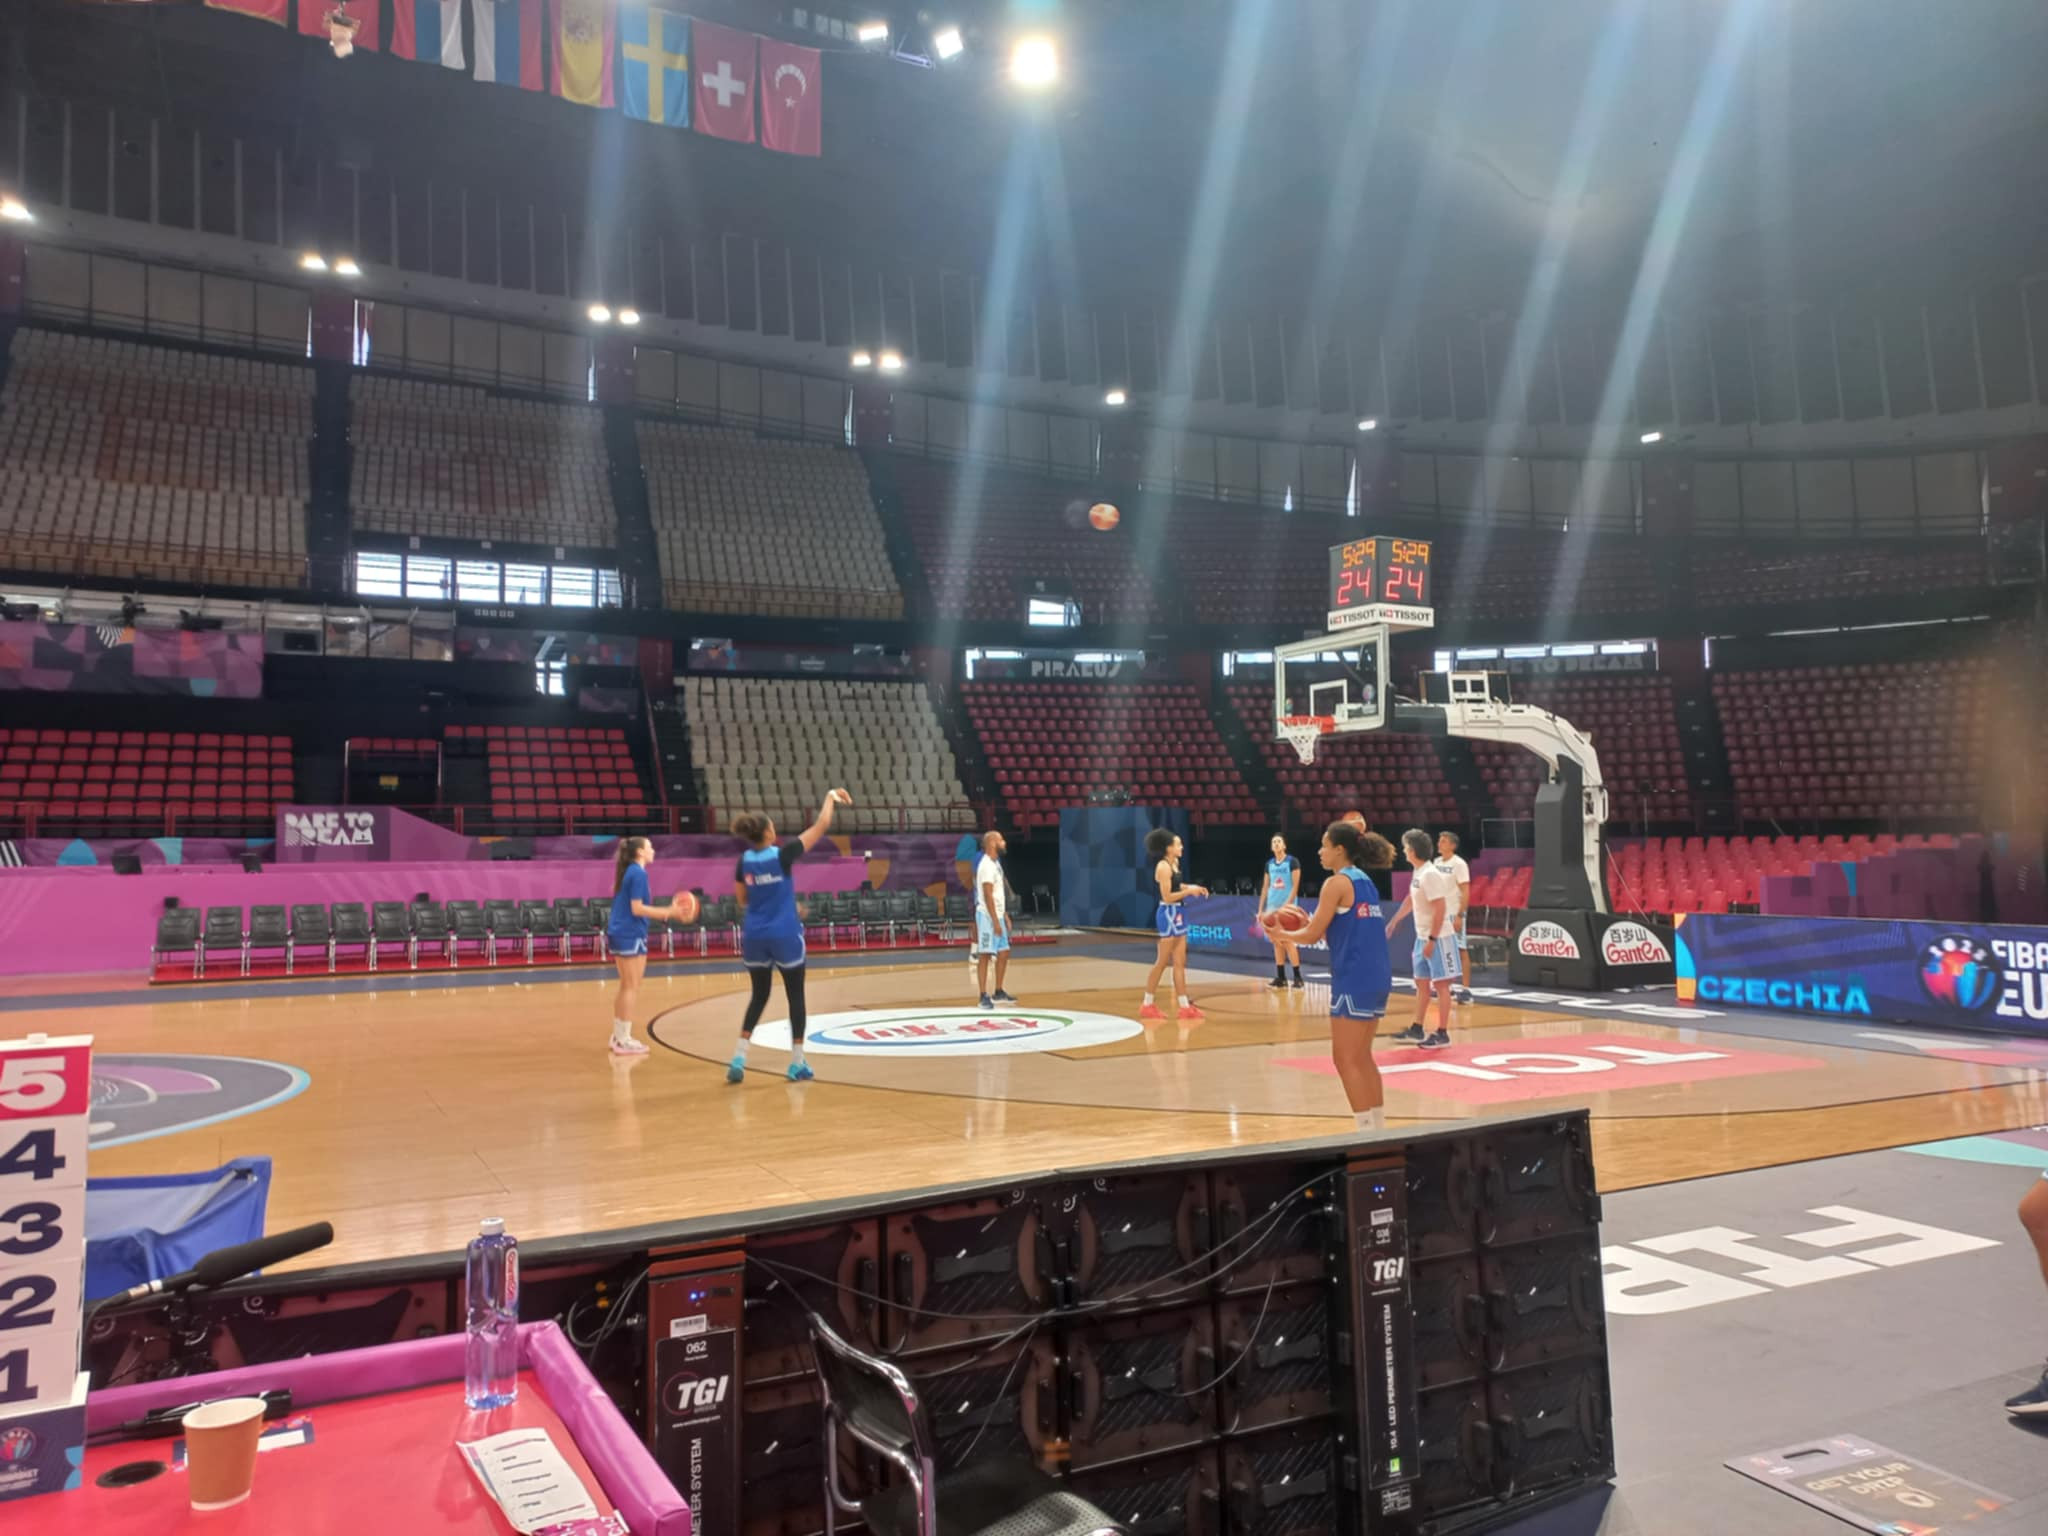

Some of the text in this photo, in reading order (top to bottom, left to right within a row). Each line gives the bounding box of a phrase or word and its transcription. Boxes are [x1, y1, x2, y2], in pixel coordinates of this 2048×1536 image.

[1343, 540, 1376, 568] 5:29
[1392, 540, 1430, 564] 5:29
[1337, 567, 1371, 605] 24
[1386, 566, 1424, 600] 24
[1343, 608, 1376, 621] TISSOT
[1395, 610, 1431, 621] TISSOT
[285, 812, 374, 830] DARE TO
[285, 828, 374, 847] DREAM
[1529, 926, 1564, 939] 百岁山
[1609, 928, 1648, 943] 百岁山
[1698, 975, 1872, 1015] CZECHIA
[1379, 1045, 1733, 1081] TCL
[0, 1056, 66, 1111] 5
[0, 1128, 66, 1180] 4
[0, 1202, 63, 1255] 3
[1373, 1257, 1405, 1281] TGI
[0, 1275, 57, 1331] 2
[1383, 1303, 1393, 1345] SYSTEM
[686, 1340, 707, 1354] 062
[0, 1348, 39, 1404] 1
[678, 1375, 729, 1410] TGI
[1385, 1347, 1396, 1405] PERIMETER
[1388, 1406, 1396, 1426] LED
[690, 1438, 702, 1490] SYSTEM
[1848, 1462, 1913, 1481] YOUR
